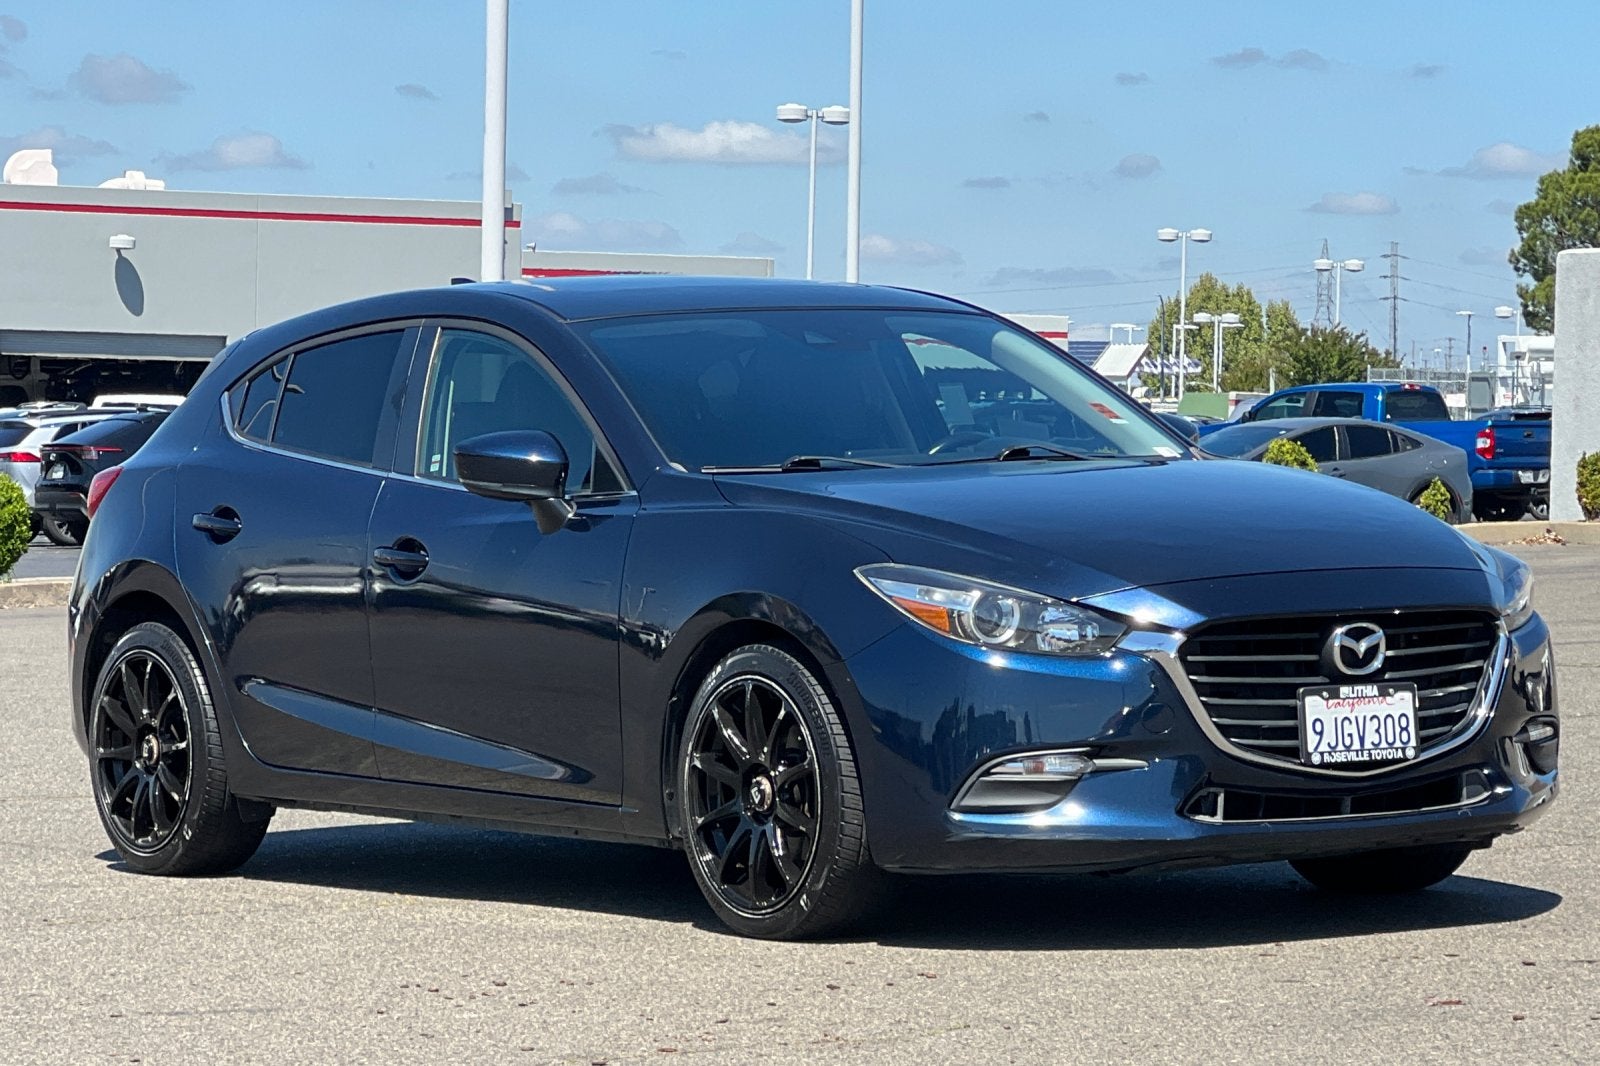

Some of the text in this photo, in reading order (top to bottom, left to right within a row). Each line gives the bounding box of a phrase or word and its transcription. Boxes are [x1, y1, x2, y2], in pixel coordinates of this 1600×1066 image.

[1349, 685, 1379, 697] LITHIA
[1312, 713, 1411, 752] 9JGV308
[1323, 749, 1403, 763] ROSEVILLE TOYOTA
